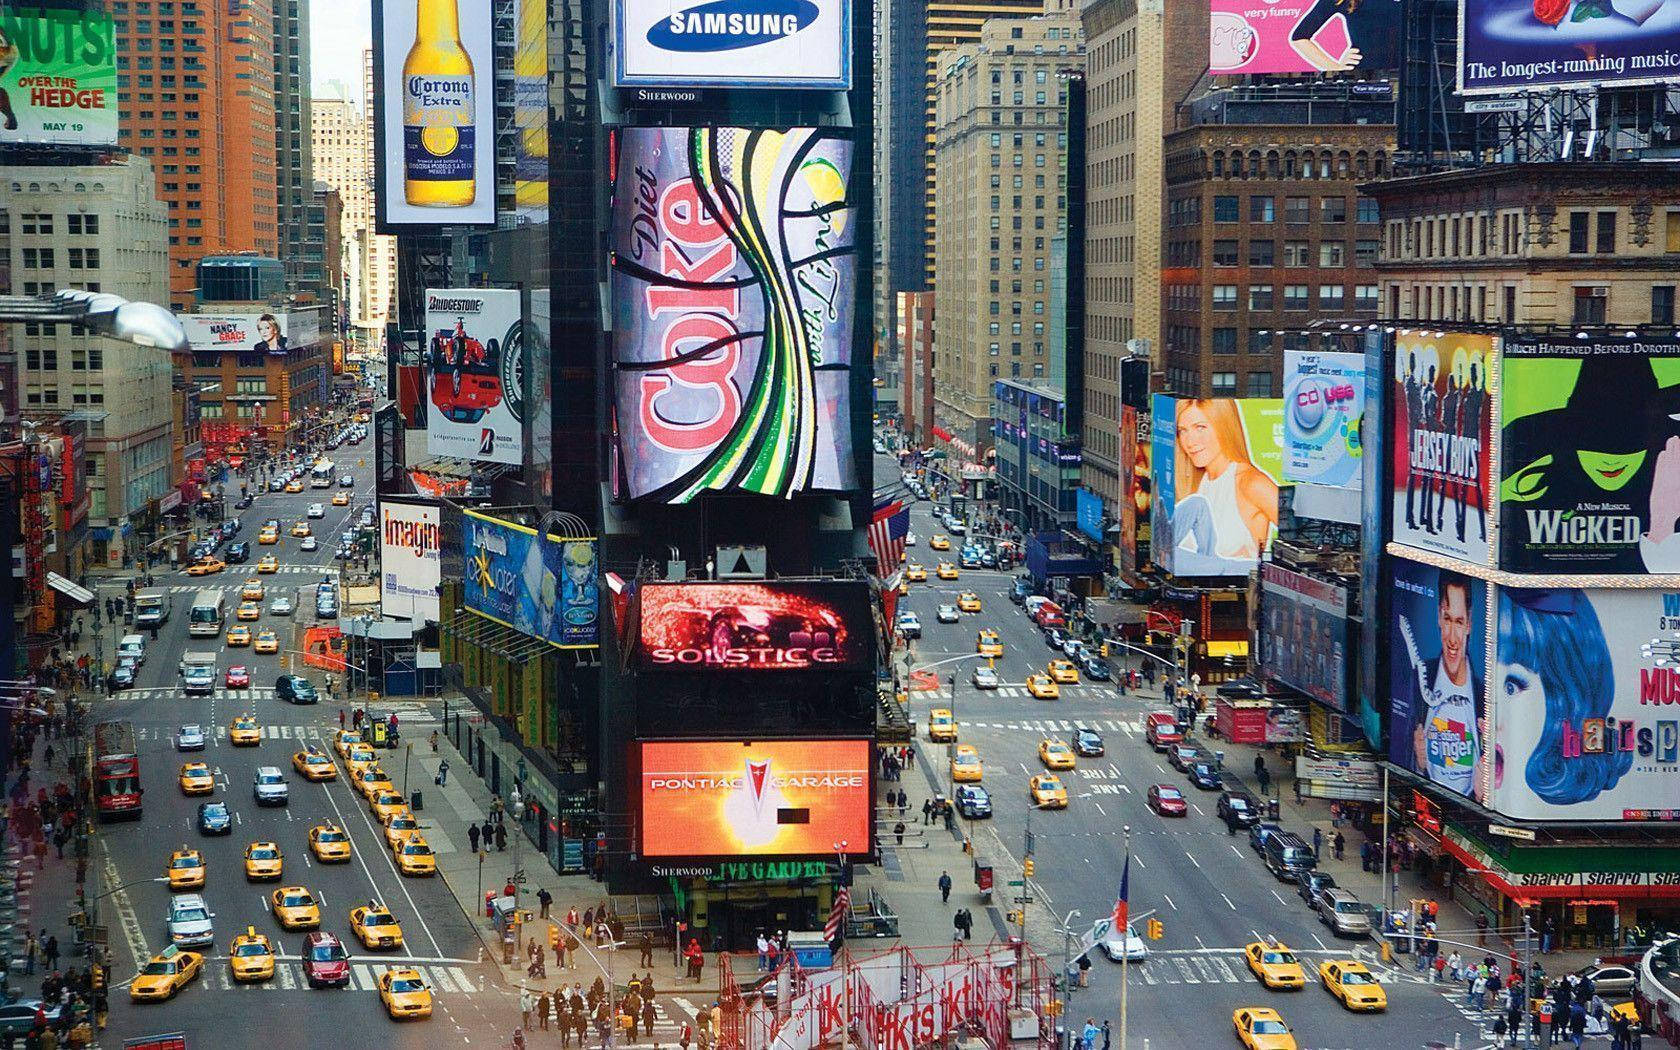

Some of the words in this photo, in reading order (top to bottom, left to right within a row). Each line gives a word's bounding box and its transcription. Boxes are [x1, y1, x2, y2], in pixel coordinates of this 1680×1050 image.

[1244, 8, 1268, 19] very
[670, 13, 798, 36] SAMSUNG
[1467, 62, 1497, 79] The
[1501, 54, 1626, 80] longest-running
[18, 77, 53, 87] OVER
[54, 77, 77, 89] THE
[409, 76, 469, 98] Corona
[30, 87, 105, 109] HEDGE
[423, 94, 461, 106] Extra
[638, 89, 696, 101] SHERWOOD
[43, 123, 67, 131] MAY
[71, 123, 84, 132] 19
[630, 166, 660, 261] Diet
[798, 200, 839, 322] Lime
[428, 295, 482, 312] BRIDGESTONE
[641, 176, 743, 454] Coke
[210, 323, 238, 334] NANCY
[219, 331, 246, 341] GRACE
[1538, 343, 1591, 354] HAPPENED
[1593, 343, 1630, 354] BEFORE
[1298, 390, 1319, 406] CD
[1411, 428, 1450, 473] JERSEY
[1450, 434, 1479, 480] BOYS
[1660, 616, 1667, 630] 8
[652, 647, 838, 664] SOLSTICE
[1430, 739, 1473, 761] singer
[1080, 769, 1119, 779] FIRE
[651, 777, 744, 790] PONTIAC
[771, 776, 863, 788] GARAGE
[1090, 784, 1133, 795] LANE
[652, 865, 713, 877] SHERWOOD
[752, 861, 827, 880] GARDEN
